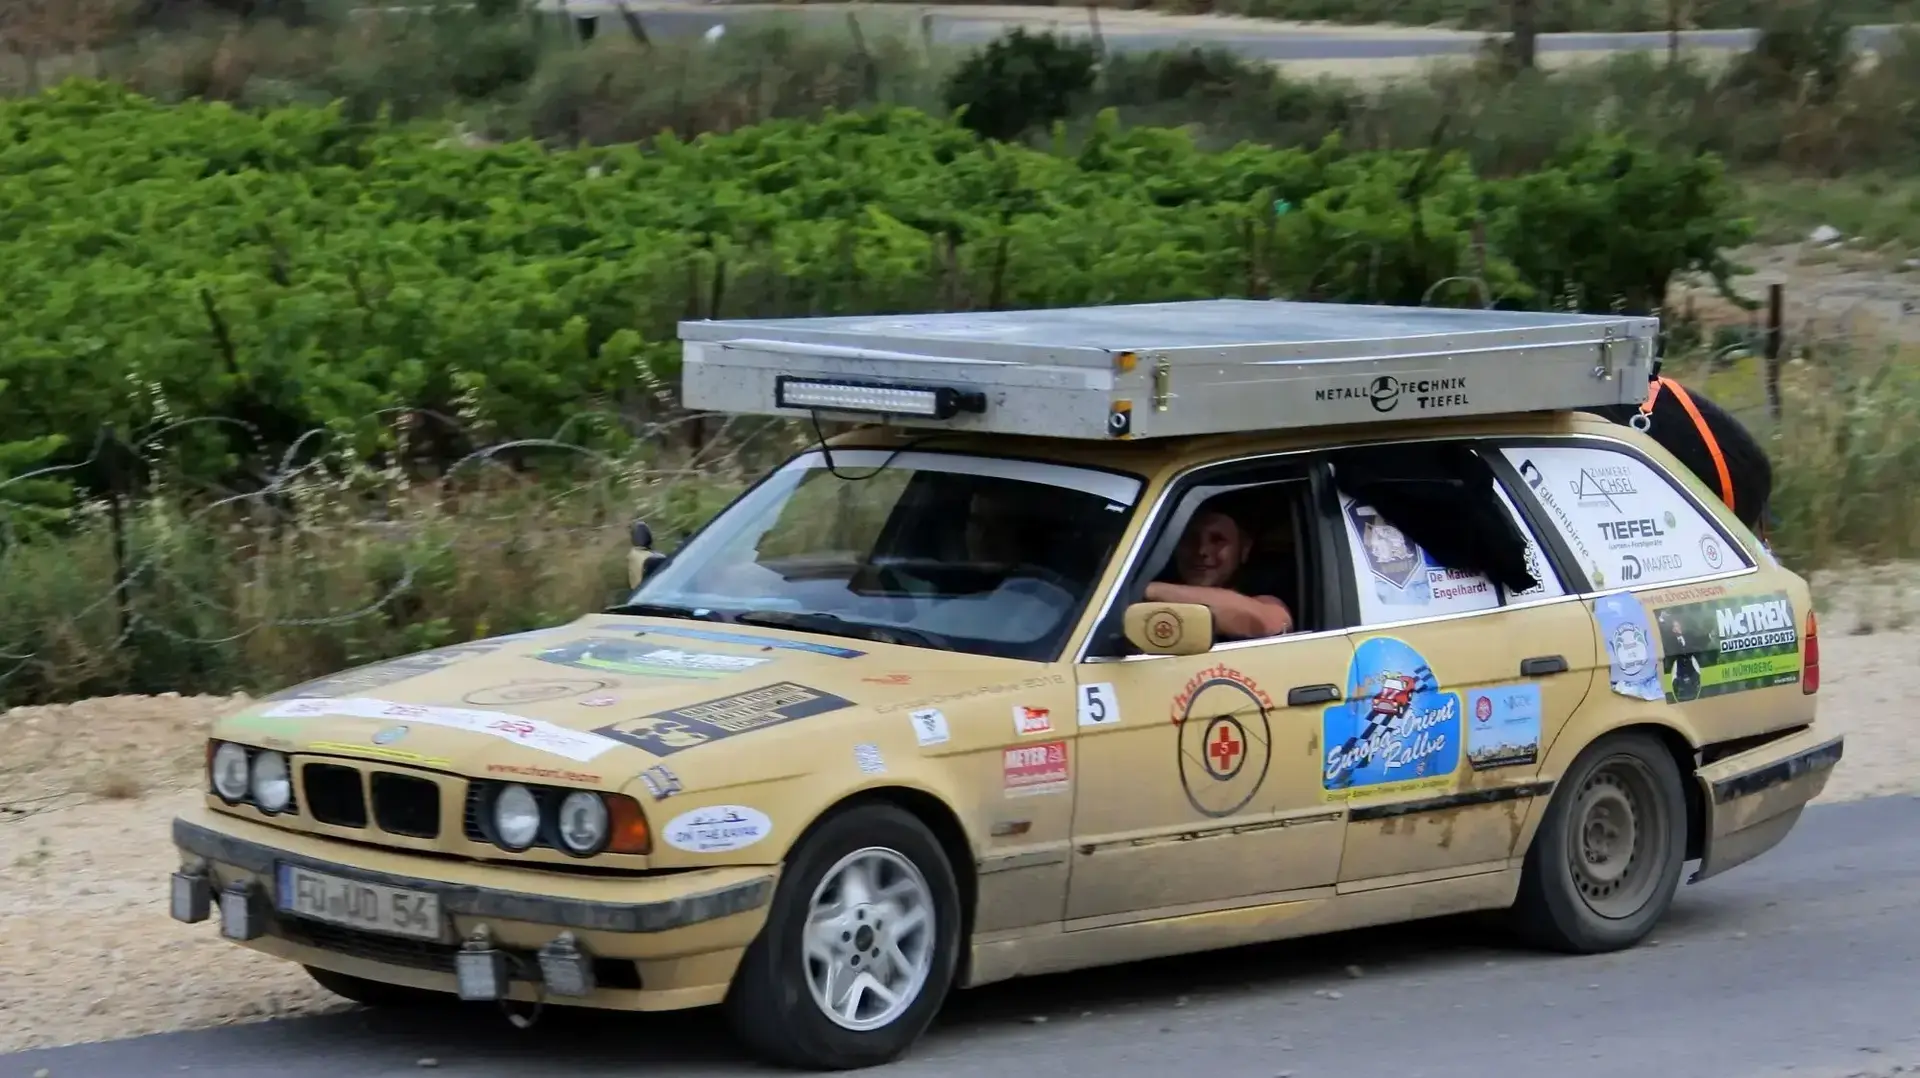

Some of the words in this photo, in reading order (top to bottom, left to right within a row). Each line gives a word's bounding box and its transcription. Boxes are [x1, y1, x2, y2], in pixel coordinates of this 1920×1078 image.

[1315, 386, 1369, 401] METALL
[1401, 376, 1467, 394] TECHNIK
[1417, 394, 1469, 409] TIEFEL
[1597, 518, 1665, 541] TIEFEL
[1642, 554, 1683, 572] MAXFELD
[1430, 572, 1443, 583] De
[1433, 583, 1488, 599] Engelhardt
[1716, 600, 1792, 637] McTREK
[1722, 636, 1763, 651] OUTDOOR
[1764, 630, 1795, 645] SPORTS
[1087, 686, 1106, 721] 5
